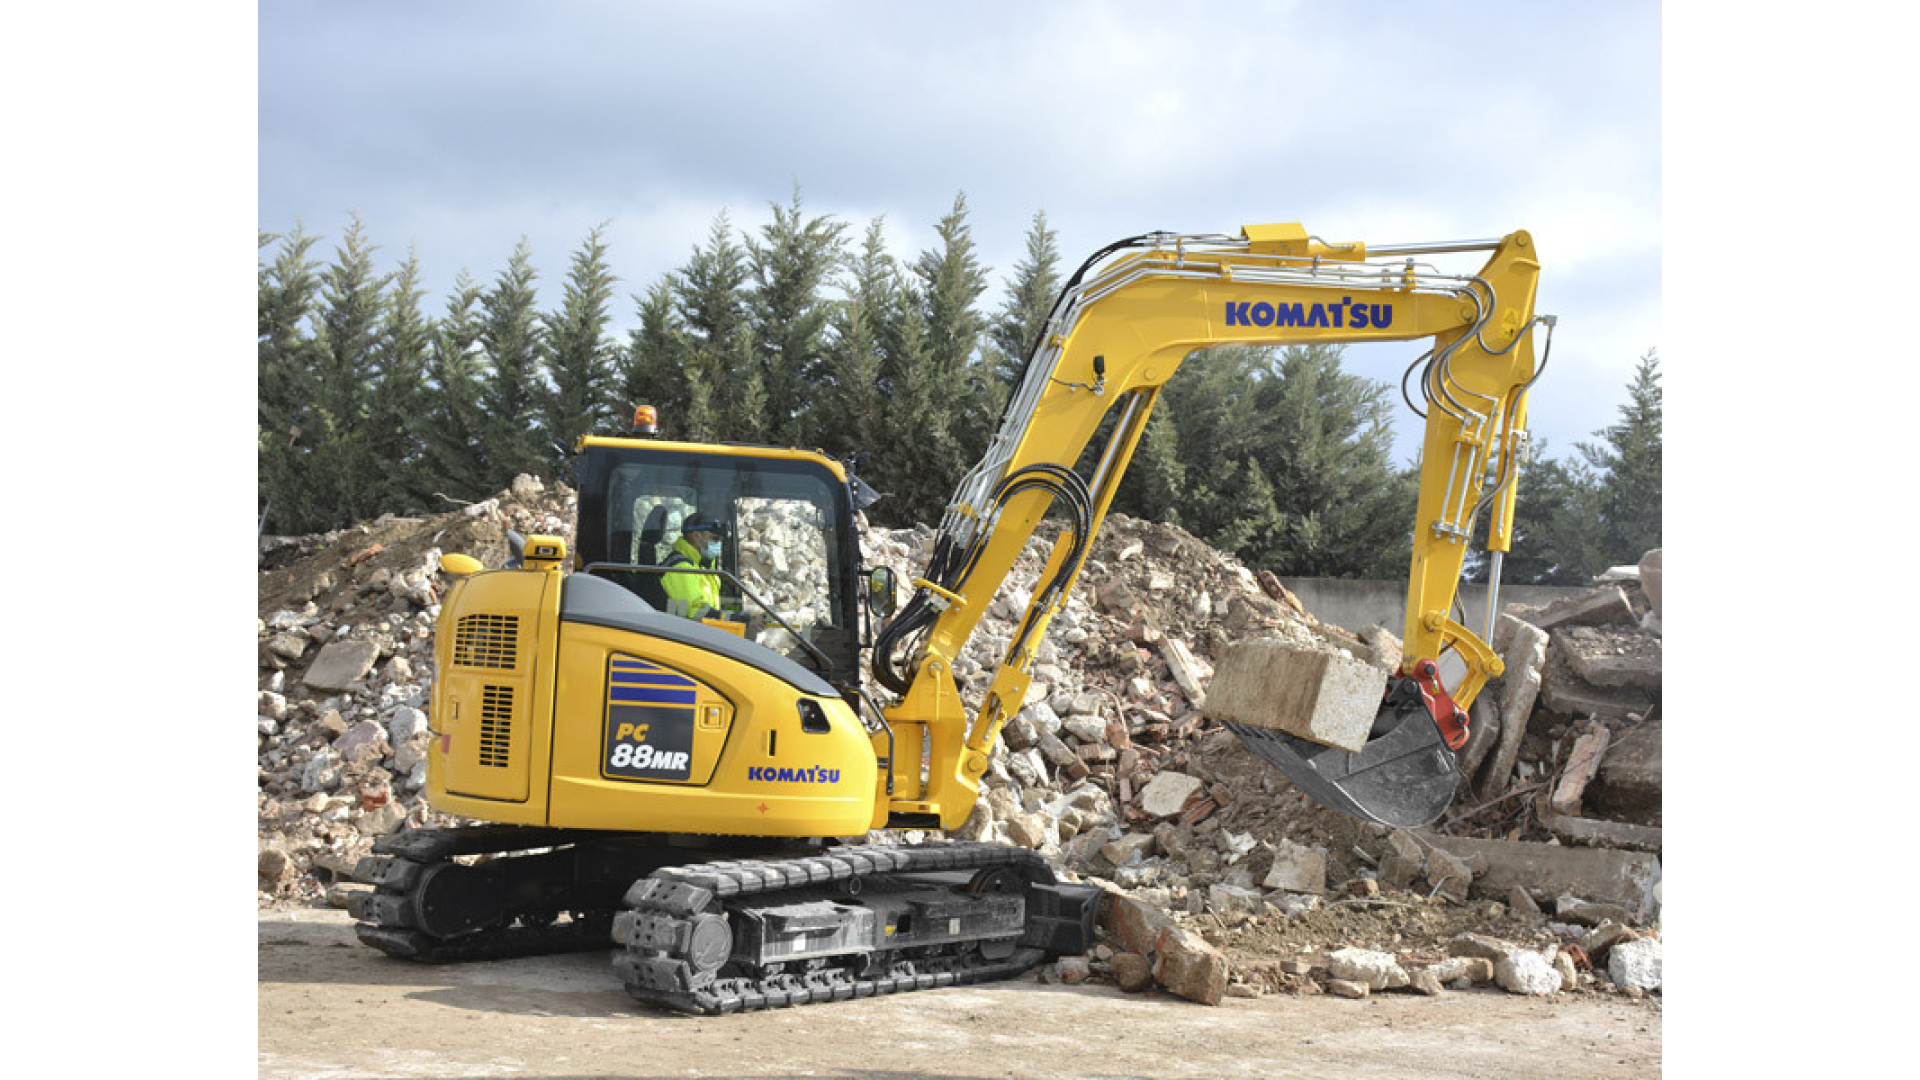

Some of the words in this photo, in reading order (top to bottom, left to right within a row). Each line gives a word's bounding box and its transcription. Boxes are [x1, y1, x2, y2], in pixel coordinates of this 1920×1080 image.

[1226, 296, 1393, 328] KOMATSU
[616, 722, 649, 742] PC
[610, 743, 689, 771] 88MR
[748, 764, 840, 783] KOMATSU
